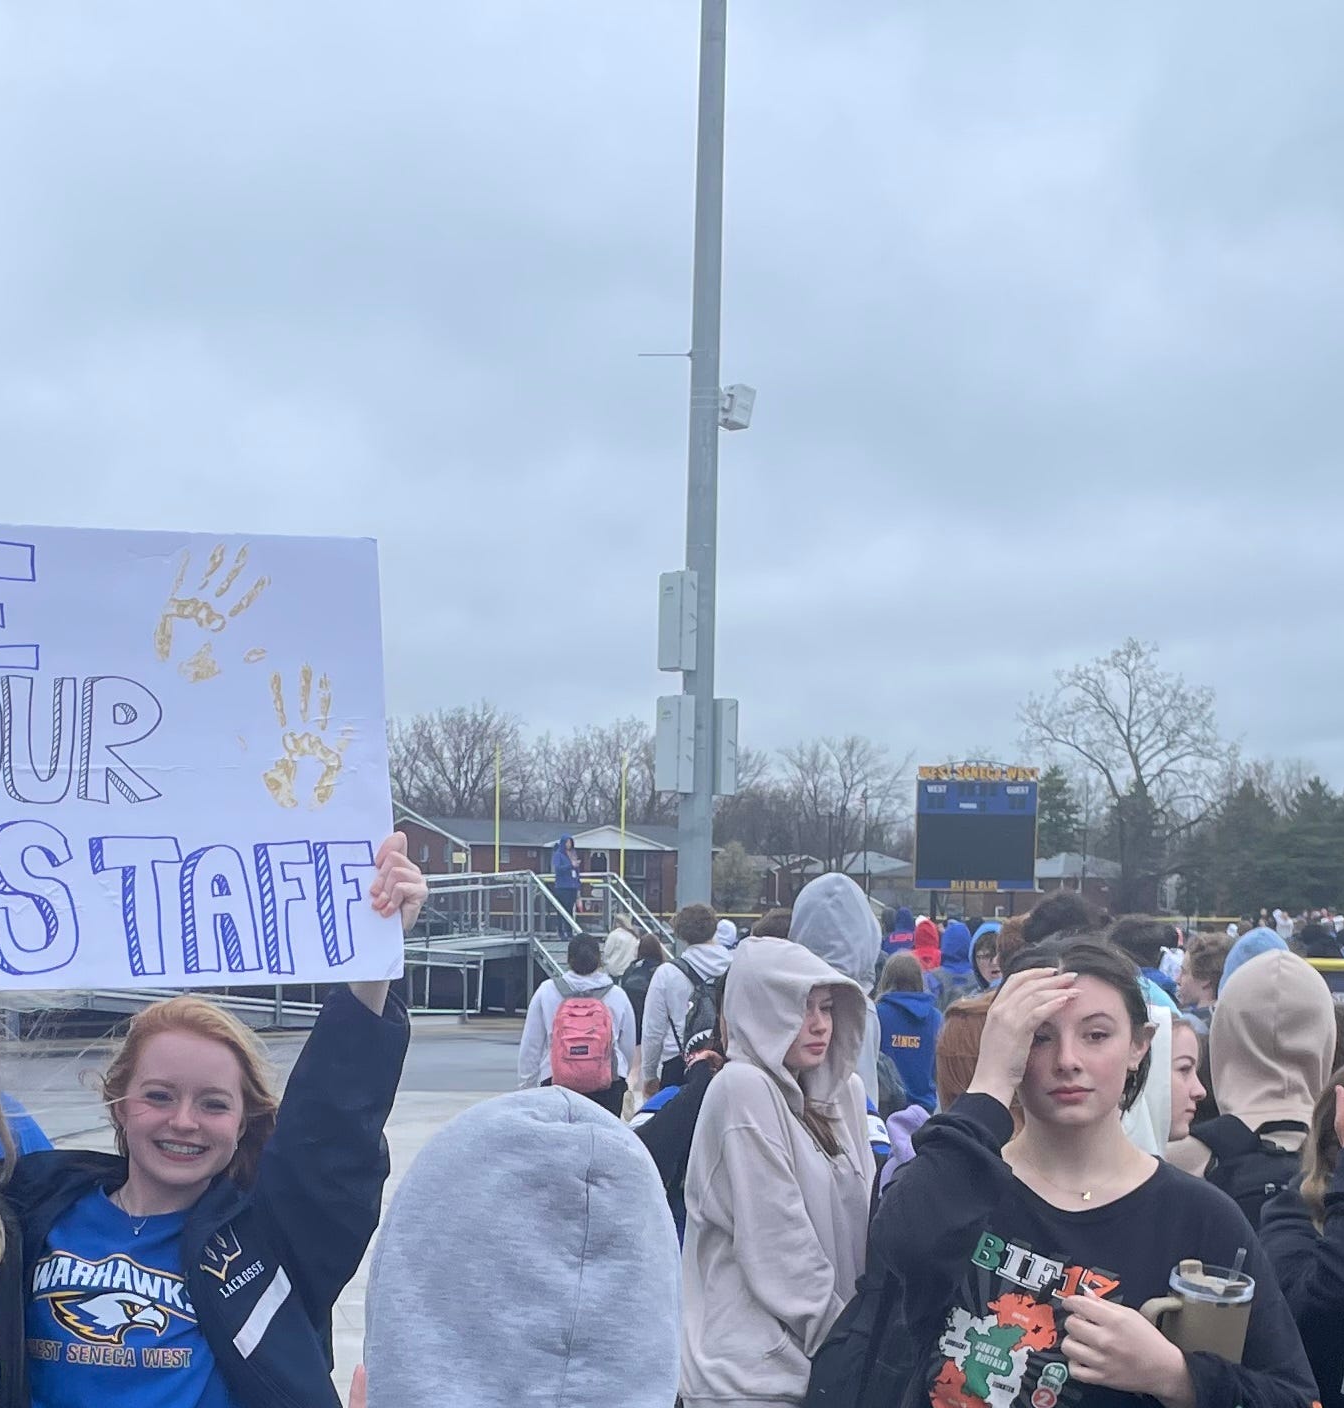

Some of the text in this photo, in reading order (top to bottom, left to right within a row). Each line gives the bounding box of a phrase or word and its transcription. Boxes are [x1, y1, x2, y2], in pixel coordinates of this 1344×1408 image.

[32, 1255, 196, 1316] WARHAWK
[217, 1259, 267, 1300] LACROSSE
[66, 1342, 138, 1368] SENECA
[142, 1347, 193, 1369] WEST
